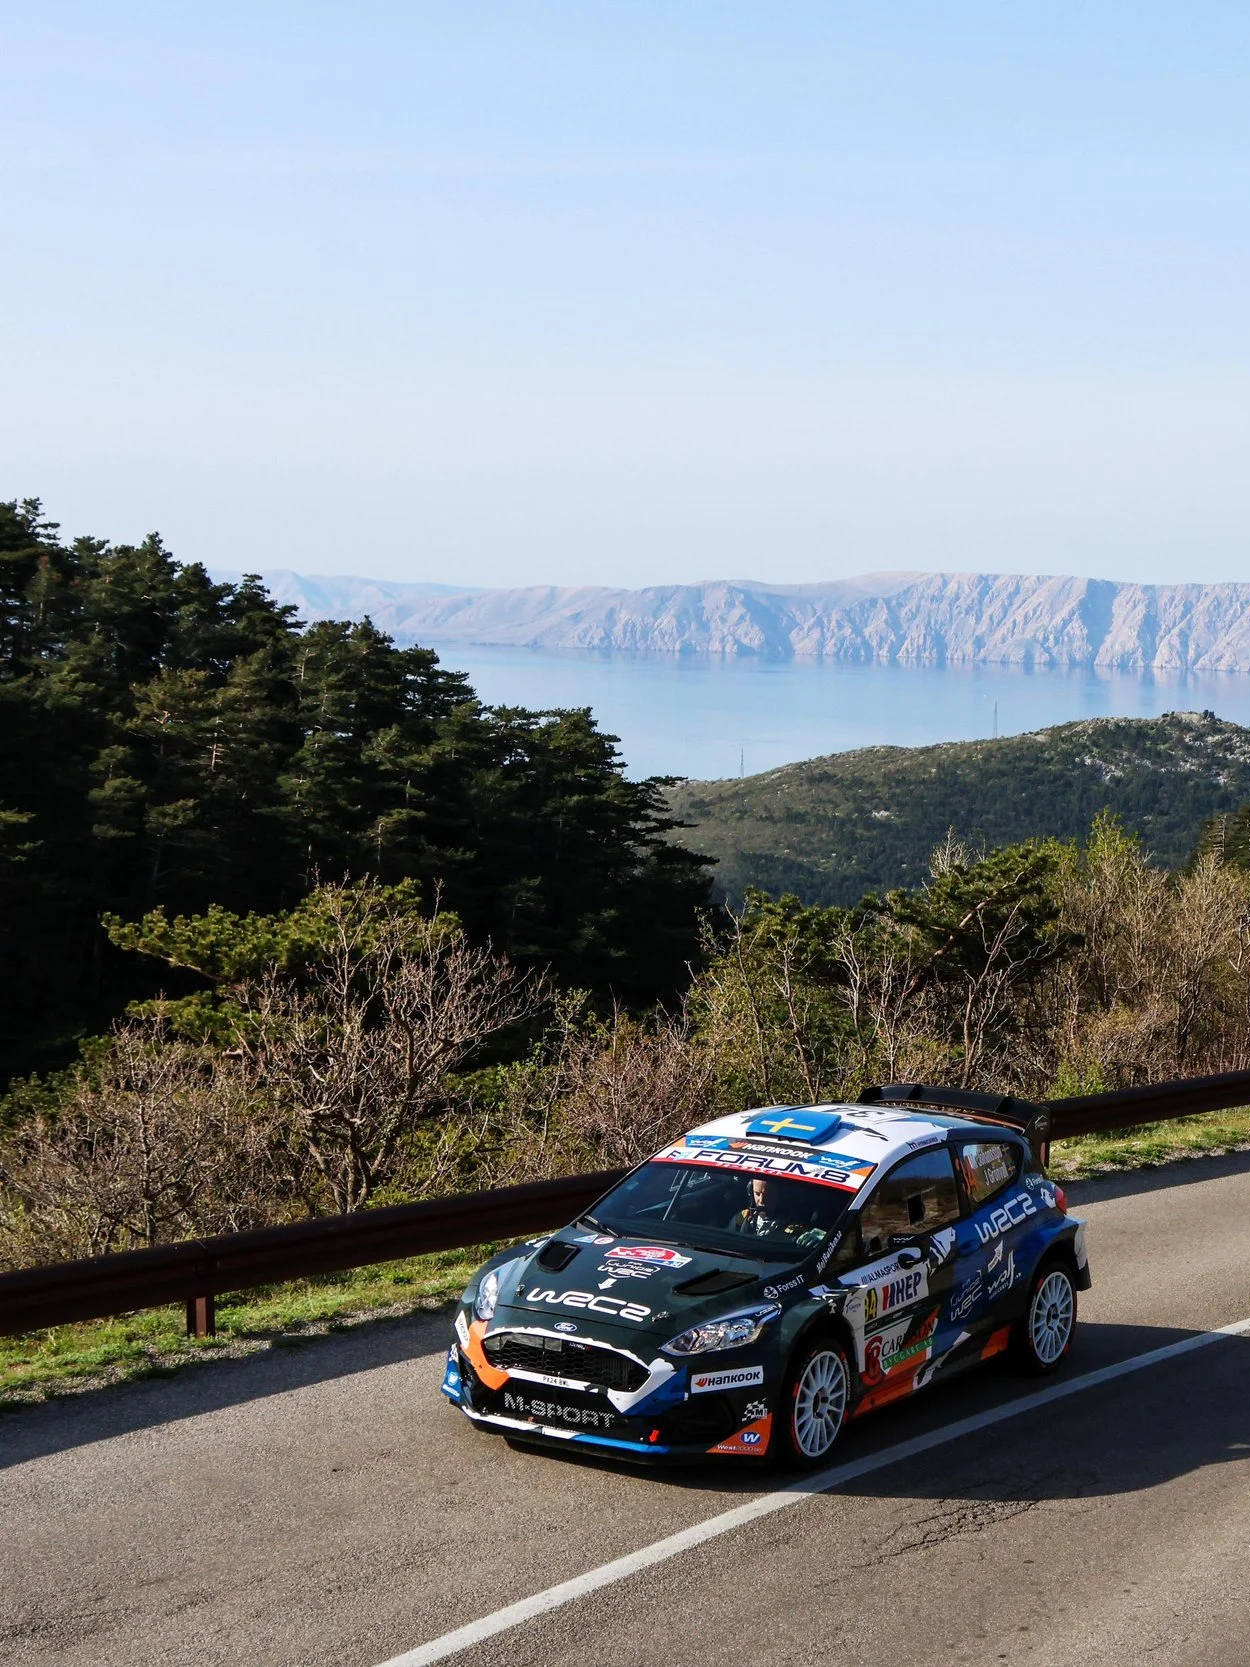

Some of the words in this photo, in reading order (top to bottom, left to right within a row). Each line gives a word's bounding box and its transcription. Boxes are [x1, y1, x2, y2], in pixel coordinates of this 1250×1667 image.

[778, 1281, 798, 1294] Forss
[526, 1287, 651, 1322] WRC2
[743, 1433, 760, 1442] W
